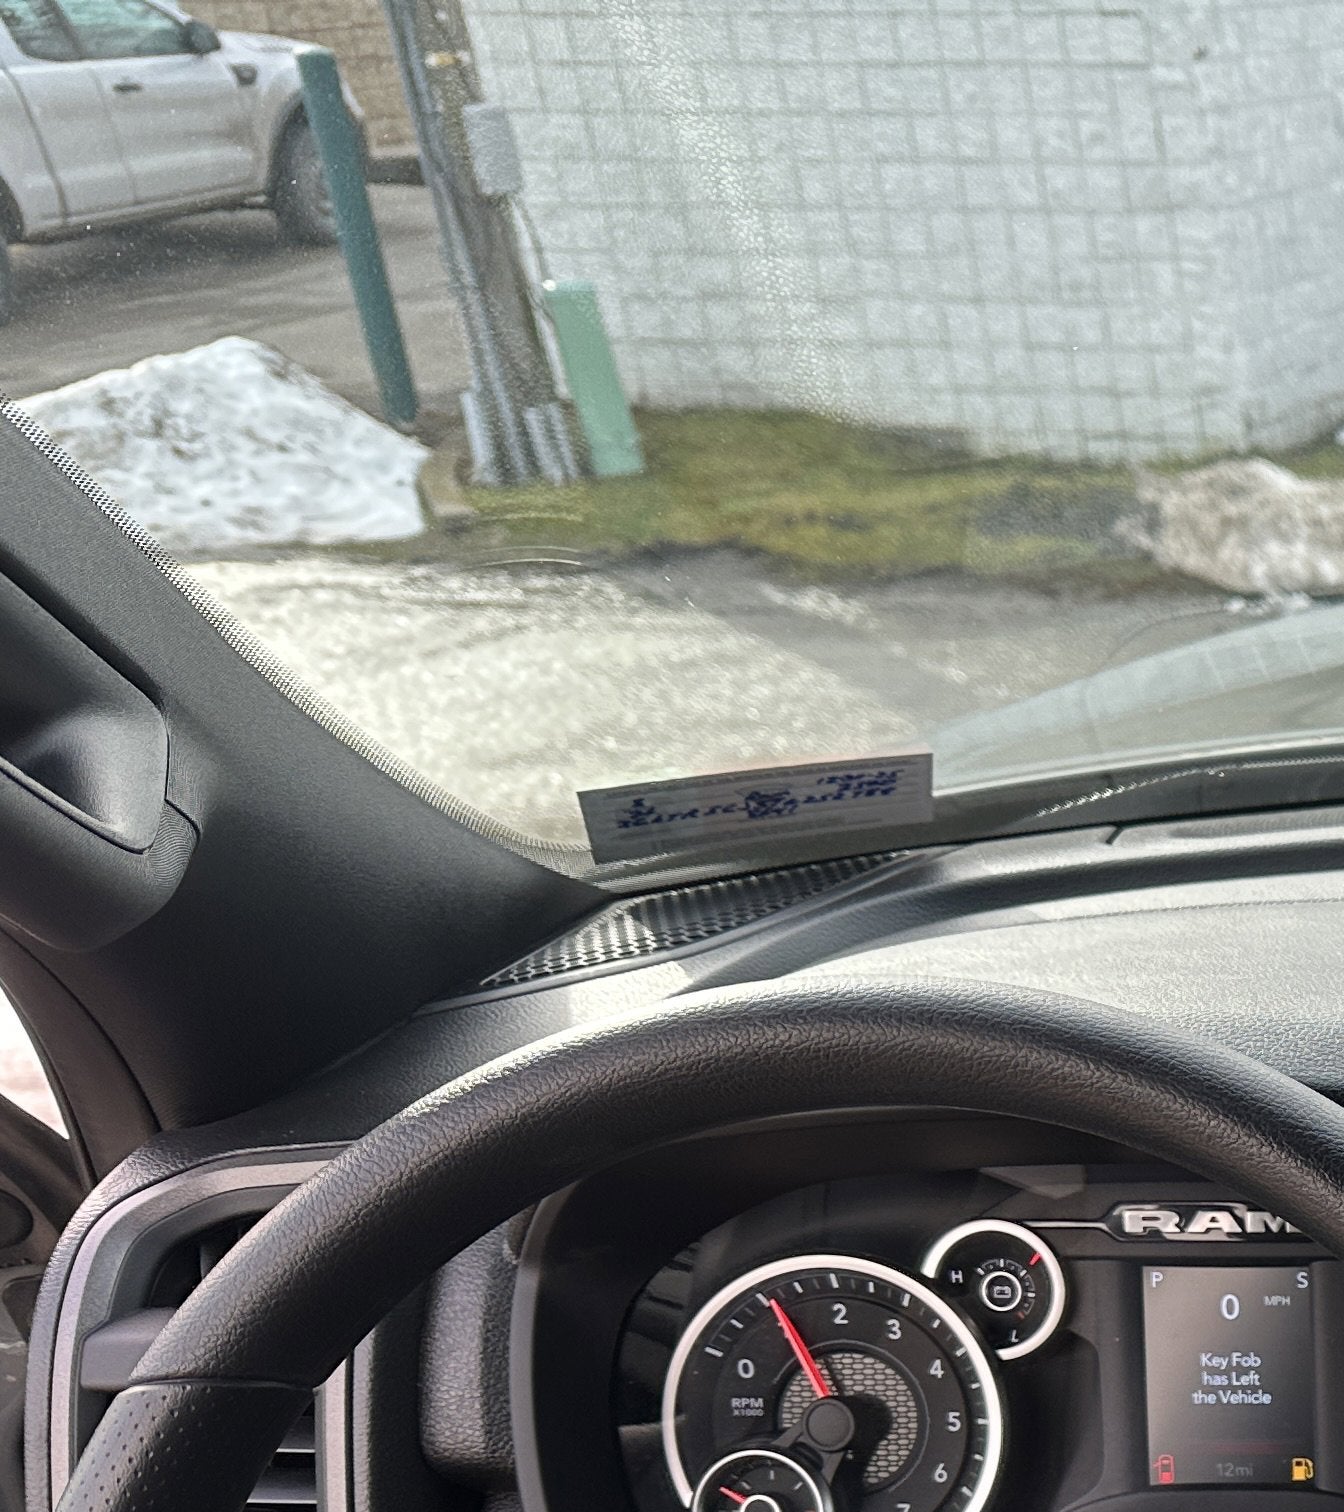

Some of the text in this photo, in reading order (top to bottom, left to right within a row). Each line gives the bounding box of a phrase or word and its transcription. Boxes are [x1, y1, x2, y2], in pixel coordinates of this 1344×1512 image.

[1122, 1210, 1301, 1234] RAM
[1152, 1272, 1164, 1287] P
[1297, 1272, 1309, 1289] S
[1219, 1294, 1241, 1320] 0
[1264, 1295, 1291, 1306] MPH
[833, 1304, 848, 1324] 2
[888, 1320, 902, 1341] 3
[737, 1359, 755, 1379] 0
[930, 1360, 944, 1378] 4
[1201, 1352, 1262, 1369] Key Fob
[1202, 1371, 1261, 1386] has Left
[731, 1397, 765, 1408] RPM
[1192, 1390, 1272, 1405] the Vehicle
[947, 1413, 961, 1431] 5
[934, 1463, 948, 1483] 6
